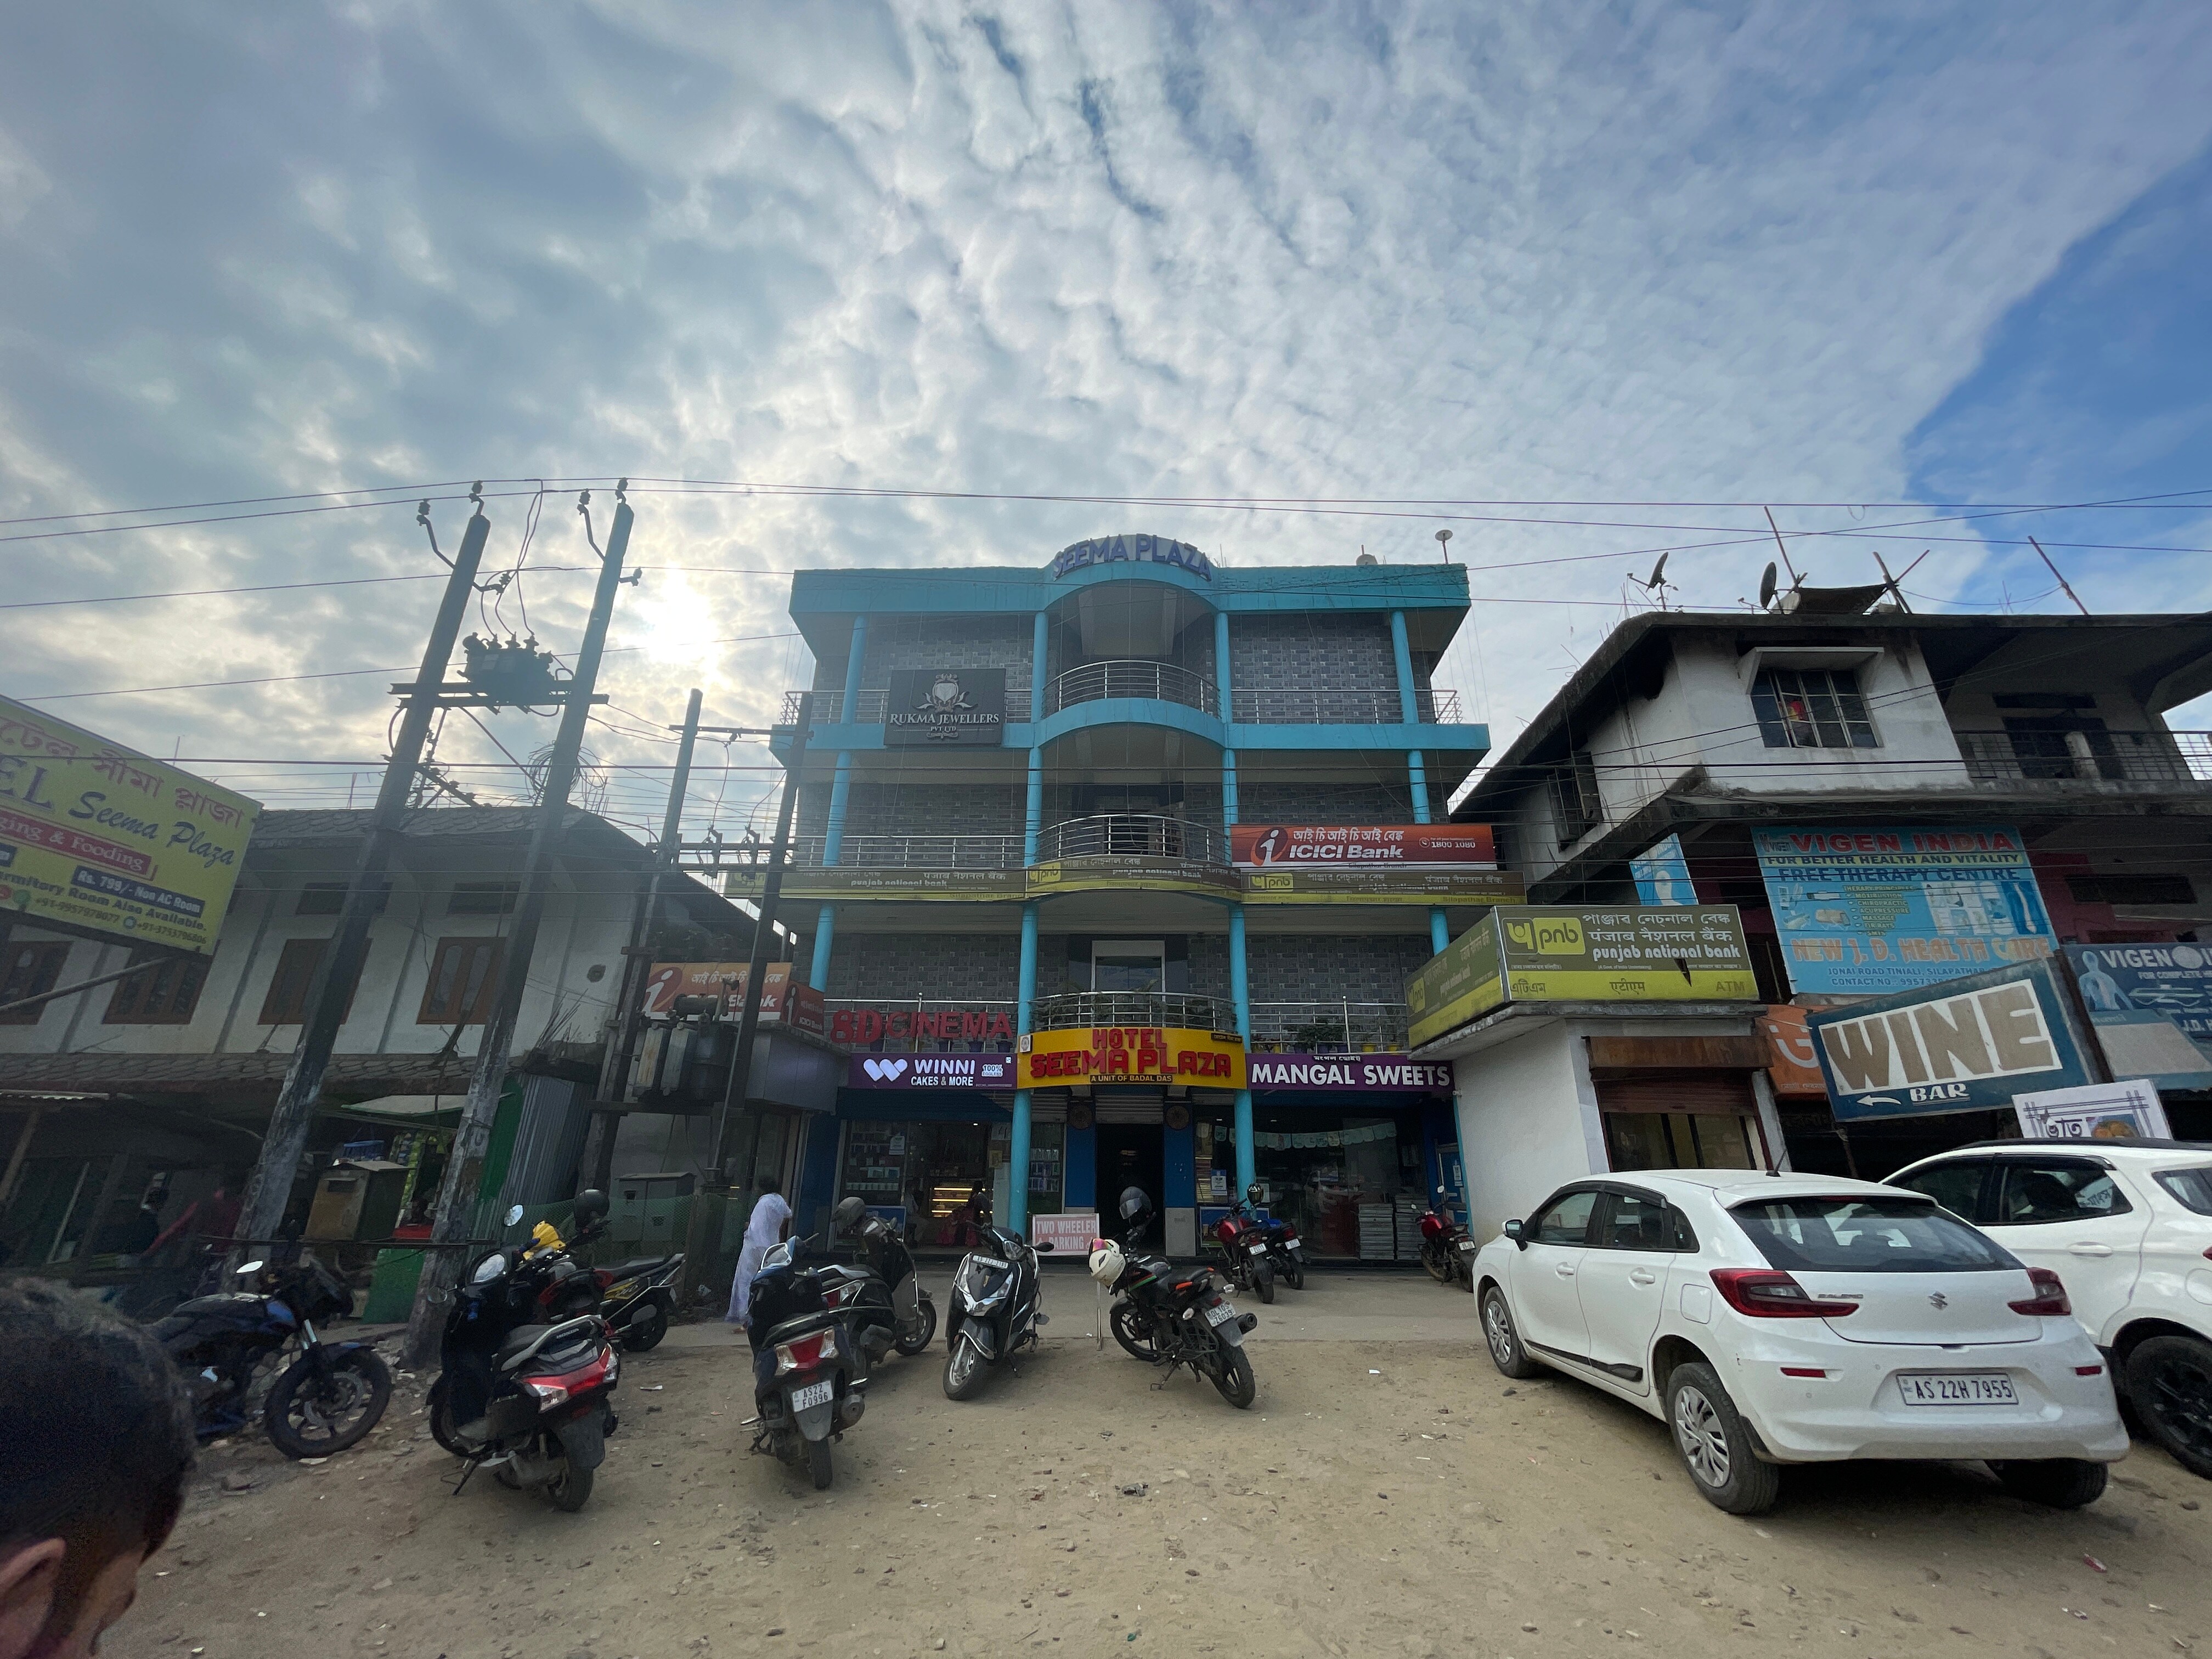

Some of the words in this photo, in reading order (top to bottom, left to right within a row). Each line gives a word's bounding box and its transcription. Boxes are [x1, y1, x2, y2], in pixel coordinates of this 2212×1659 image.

[1052, 534, 1129, 581] SEEMA
[1135, 533, 1212, 582] PLAZA
[889, 713, 936, 725] RUKMA
[937, 713, 1000, 725] JEWELLERS
[69, 791, 159, 839] Seema
[166, 821, 235, 868] Plaza
[49, 831, 66, 845] &
[71, 836, 144, 871] Fooding
[1788, 833, 1903, 853] VIGEN
[1912, 832, 2017, 851] INDIA
[1289, 844, 1344, 859] ICICI
[1346, 844, 1404, 859] Bank
[1768, 856, 1797, 865] FOR
[1801, 856, 1855, 865] BETTER
[1860, 855, 1916, 865] HEALTH
[1921, 855, 1952, 864] AND
[1954, 854, 2019, 864] VITALITY
[1040, 866, 1058, 881] pnb
[1778, 867, 1832, 881] FREE
[1835, 867, 1933, 881] THERAPY
[1935, 867, 2020, 881] CENTRE
[851, 879, 883, 887] punjab
[1268, 879, 1291, 889] pnb
[68, 888, 110, 906] Room
[112, 900, 143, 915] Also
[157, 893, 173, 905] AC
[173, 897, 201, 913] Room
[1540, 923, 1578, 949] pnb
[1587, 928, 1635, 943] पंजाब
[1639, 928, 1696, 942] नैशनल
[1699, 927, 1733, 942] बैंक
[1593, 945, 1641, 962] punjab
[1645, 944, 1701, 959] national
[1704, 944, 1741, 958] bank
[1790, 938, 1844, 962] NEW
[1898, 938, 1990, 964] HEALTH
[2100, 949, 2174, 968] VIGEN
[1510, 977, 1547, 994] এটিএম
[1609, 978, 1646, 994] एटीएम
[1716, 981, 1745, 992] ATM
[728, 994, 778, 1008] Bak
[831, 1009, 882, 1043] 8D
[885, 1011, 1013, 1040] CINEMA
[1092, 1028, 1167, 1049] HOTEL
[1820, 985, 2055, 1091] WINE
[914, 1059, 976, 1075] WINNI
[1030, 1049, 1129, 1078] SEEMA
[1137, 1048, 1232, 1077] PLAZA
[911, 1076, 939, 1086] CAKES
[941, 1076, 947, 1086] &
[949, 1076, 974, 1086] MORE
[1251, 1063, 1355, 1085] MANGAL
[1363, 1065, 1451, 1086] SWEETS
[1909, 1083, 1970, 1103] BAR
[1036, 1221, 1055, 1234] TWO
[1057, 1220, 1096, 1234] WHEELER
[1048, 1236, 1085, 1250] PARKING
[803, 1384, 823, 1398] AS22
[1915, 1380, 1936, 1399] AS
[1937, 1380, 1970, 1399] 22H
[1971, 1380, 2012, 1398] 7955
